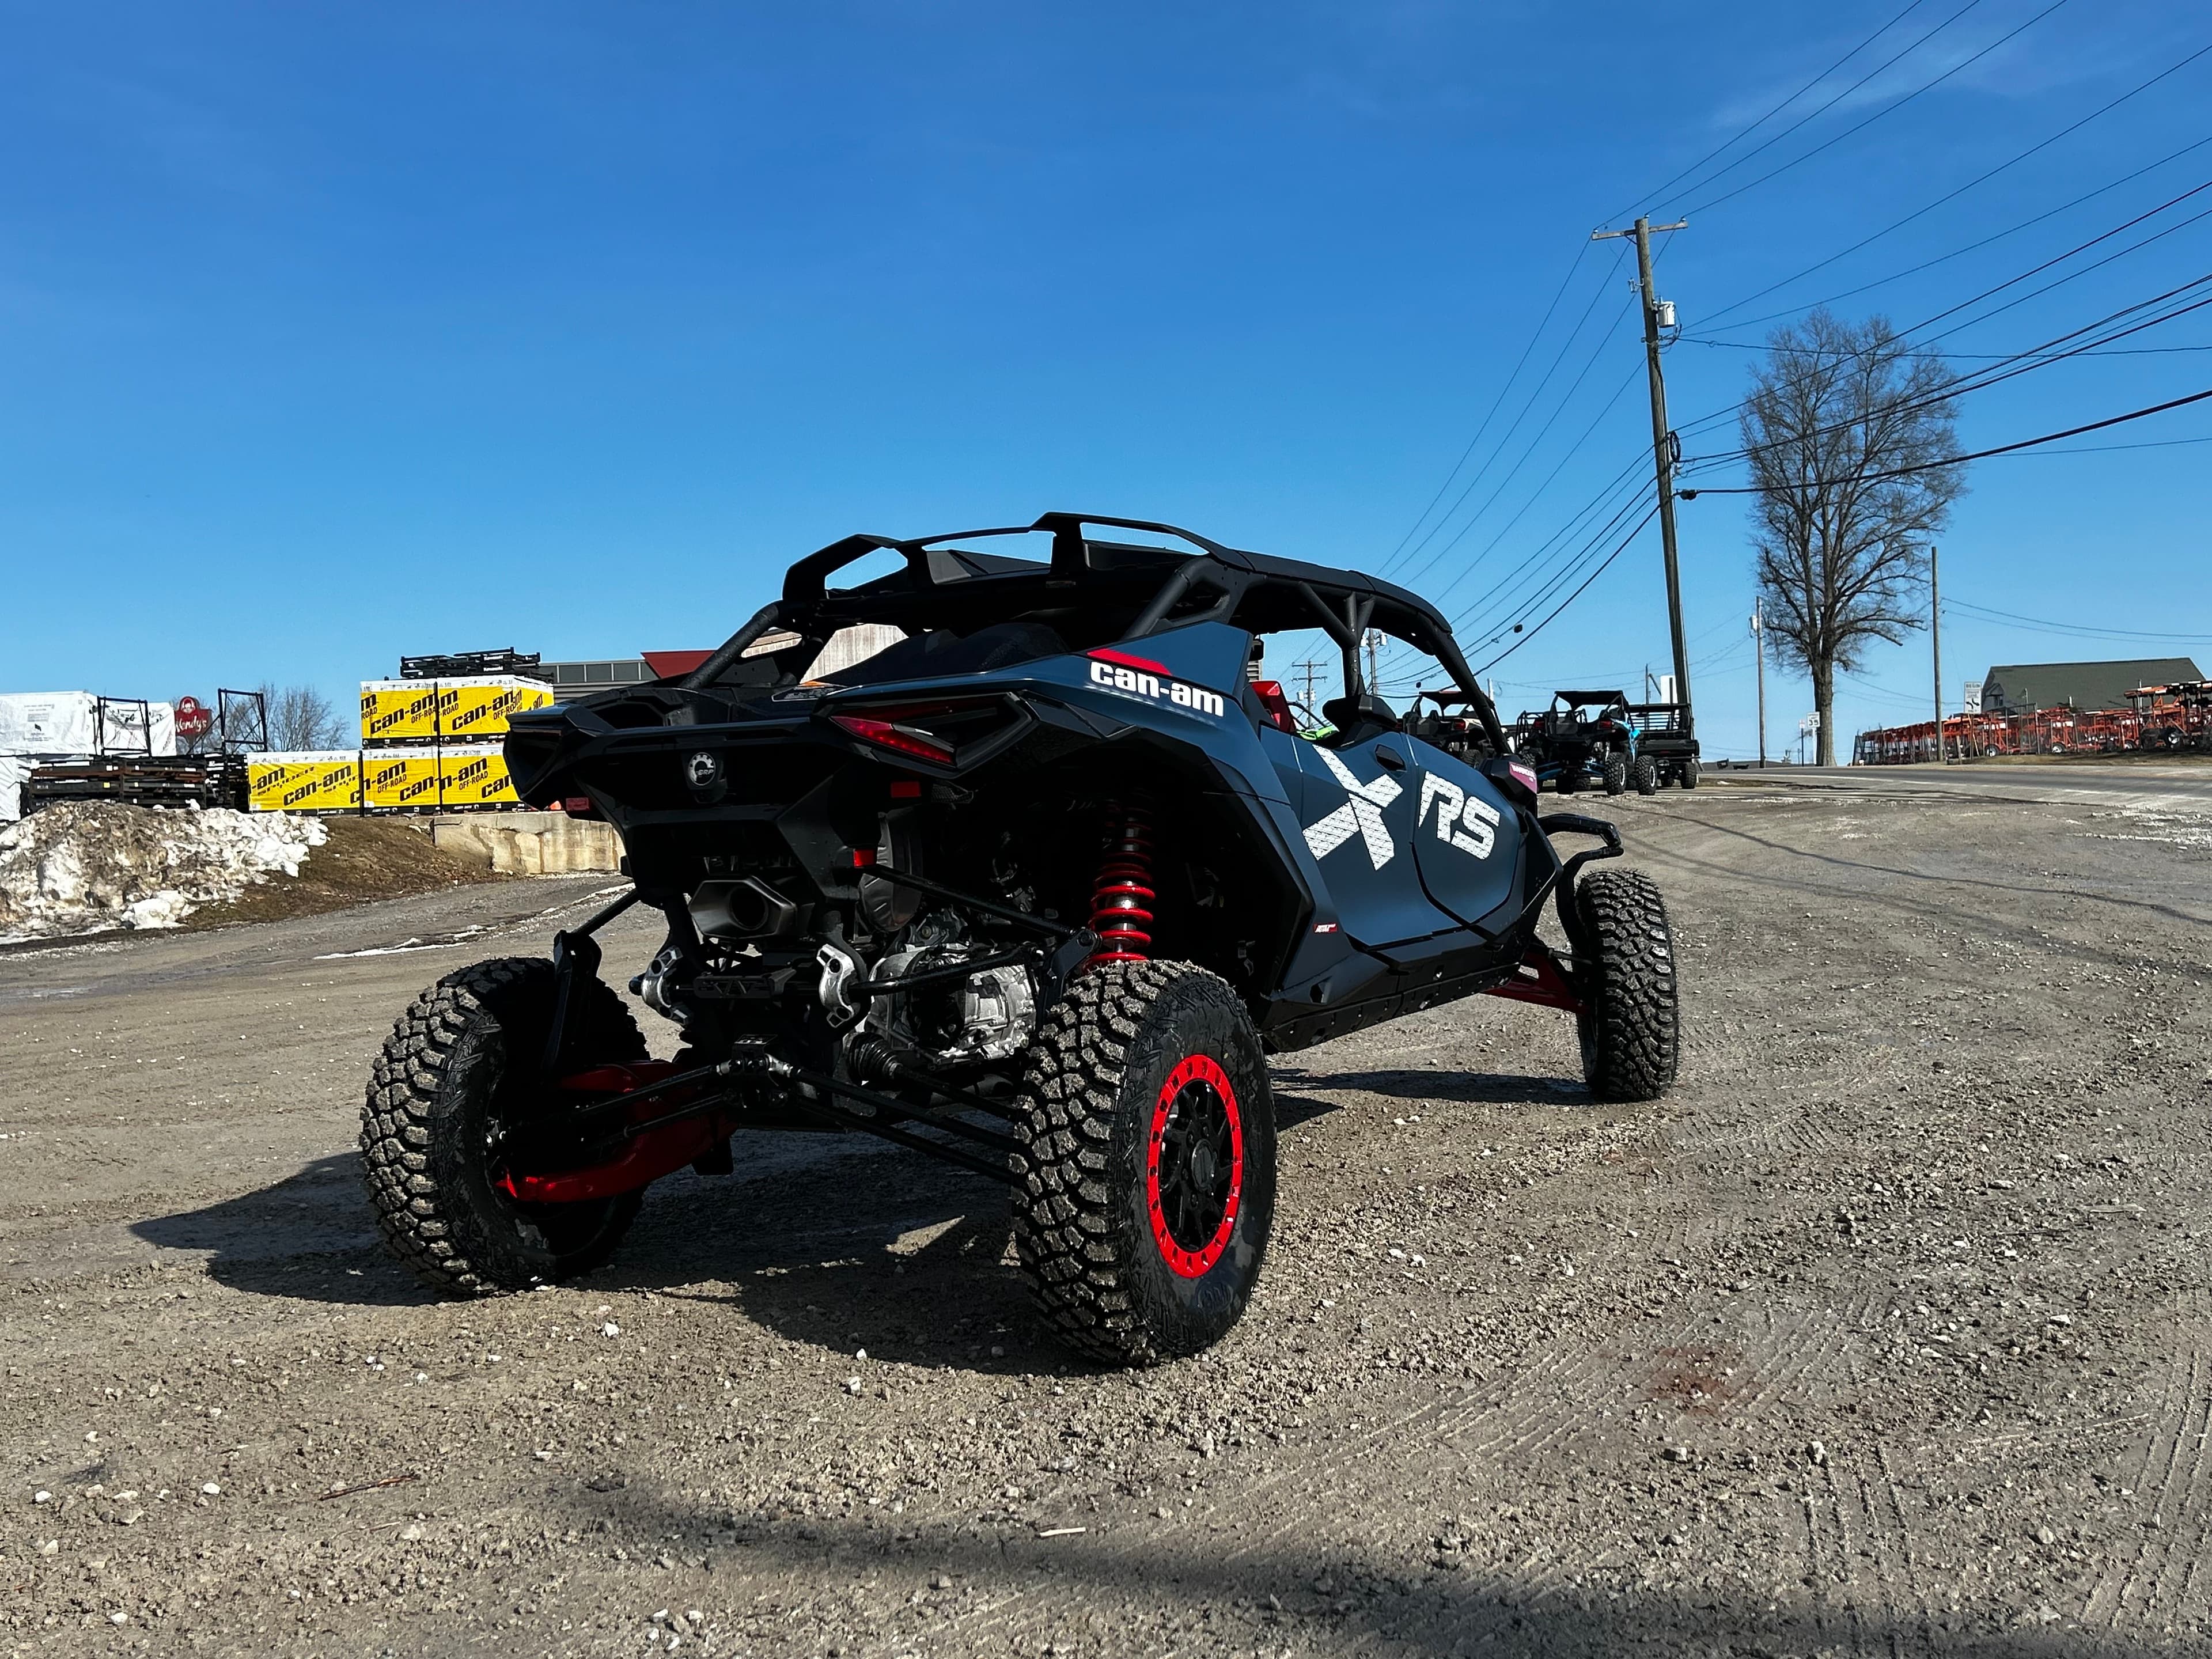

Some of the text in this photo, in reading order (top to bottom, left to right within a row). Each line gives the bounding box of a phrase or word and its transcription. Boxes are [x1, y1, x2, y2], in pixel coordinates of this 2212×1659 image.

[1090, 661, 1224, 717] can-am
[283, 765, 351, 806] can-am
[377, 774, 407, 794] OFF-ROAD
[459, 771, 488, 791] OFF-ROAD
[1302, 744, 1501, 870] X RS
